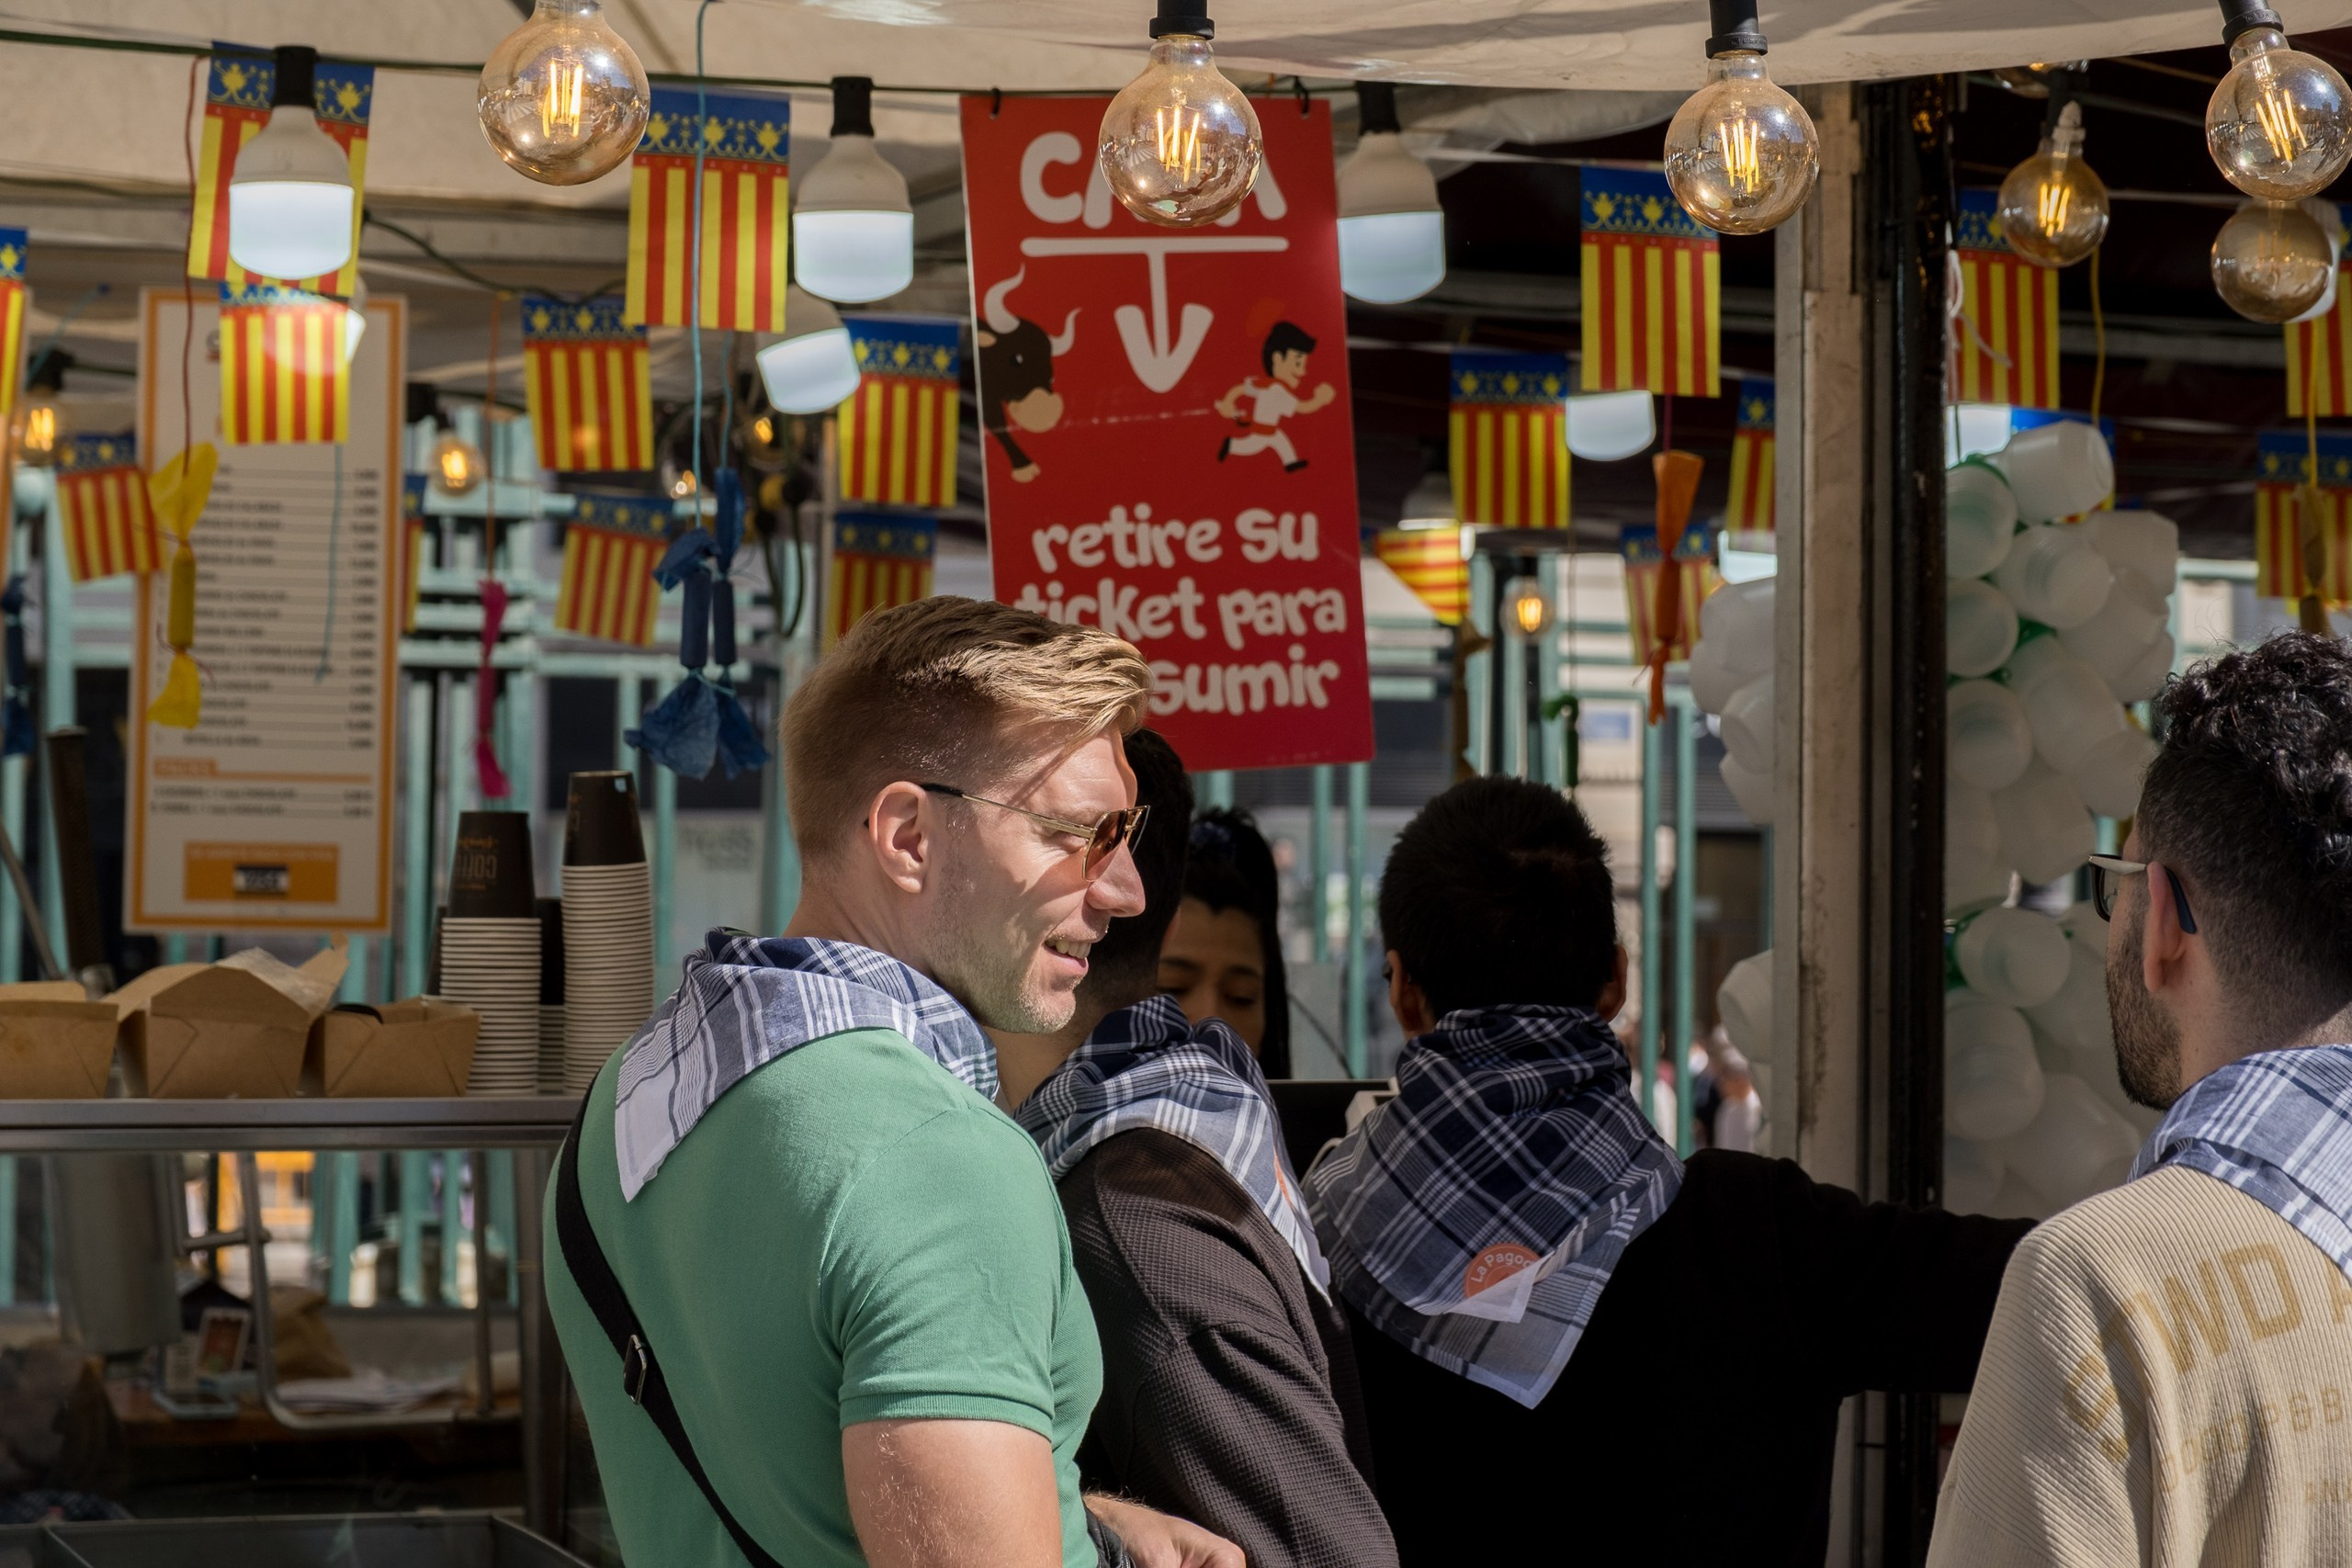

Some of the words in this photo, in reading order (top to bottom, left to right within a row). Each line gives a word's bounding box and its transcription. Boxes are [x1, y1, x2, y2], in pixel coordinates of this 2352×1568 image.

[1032, 502, 1223, 573] retire
[1235, 508, 1320, 563] su
[1013, 576, 1207, 642] ticket
[1217, 587, 1347, 650] para
[1148, 643, 1340, 716] sumir
[1470, 1266, 1487, 1282] La
